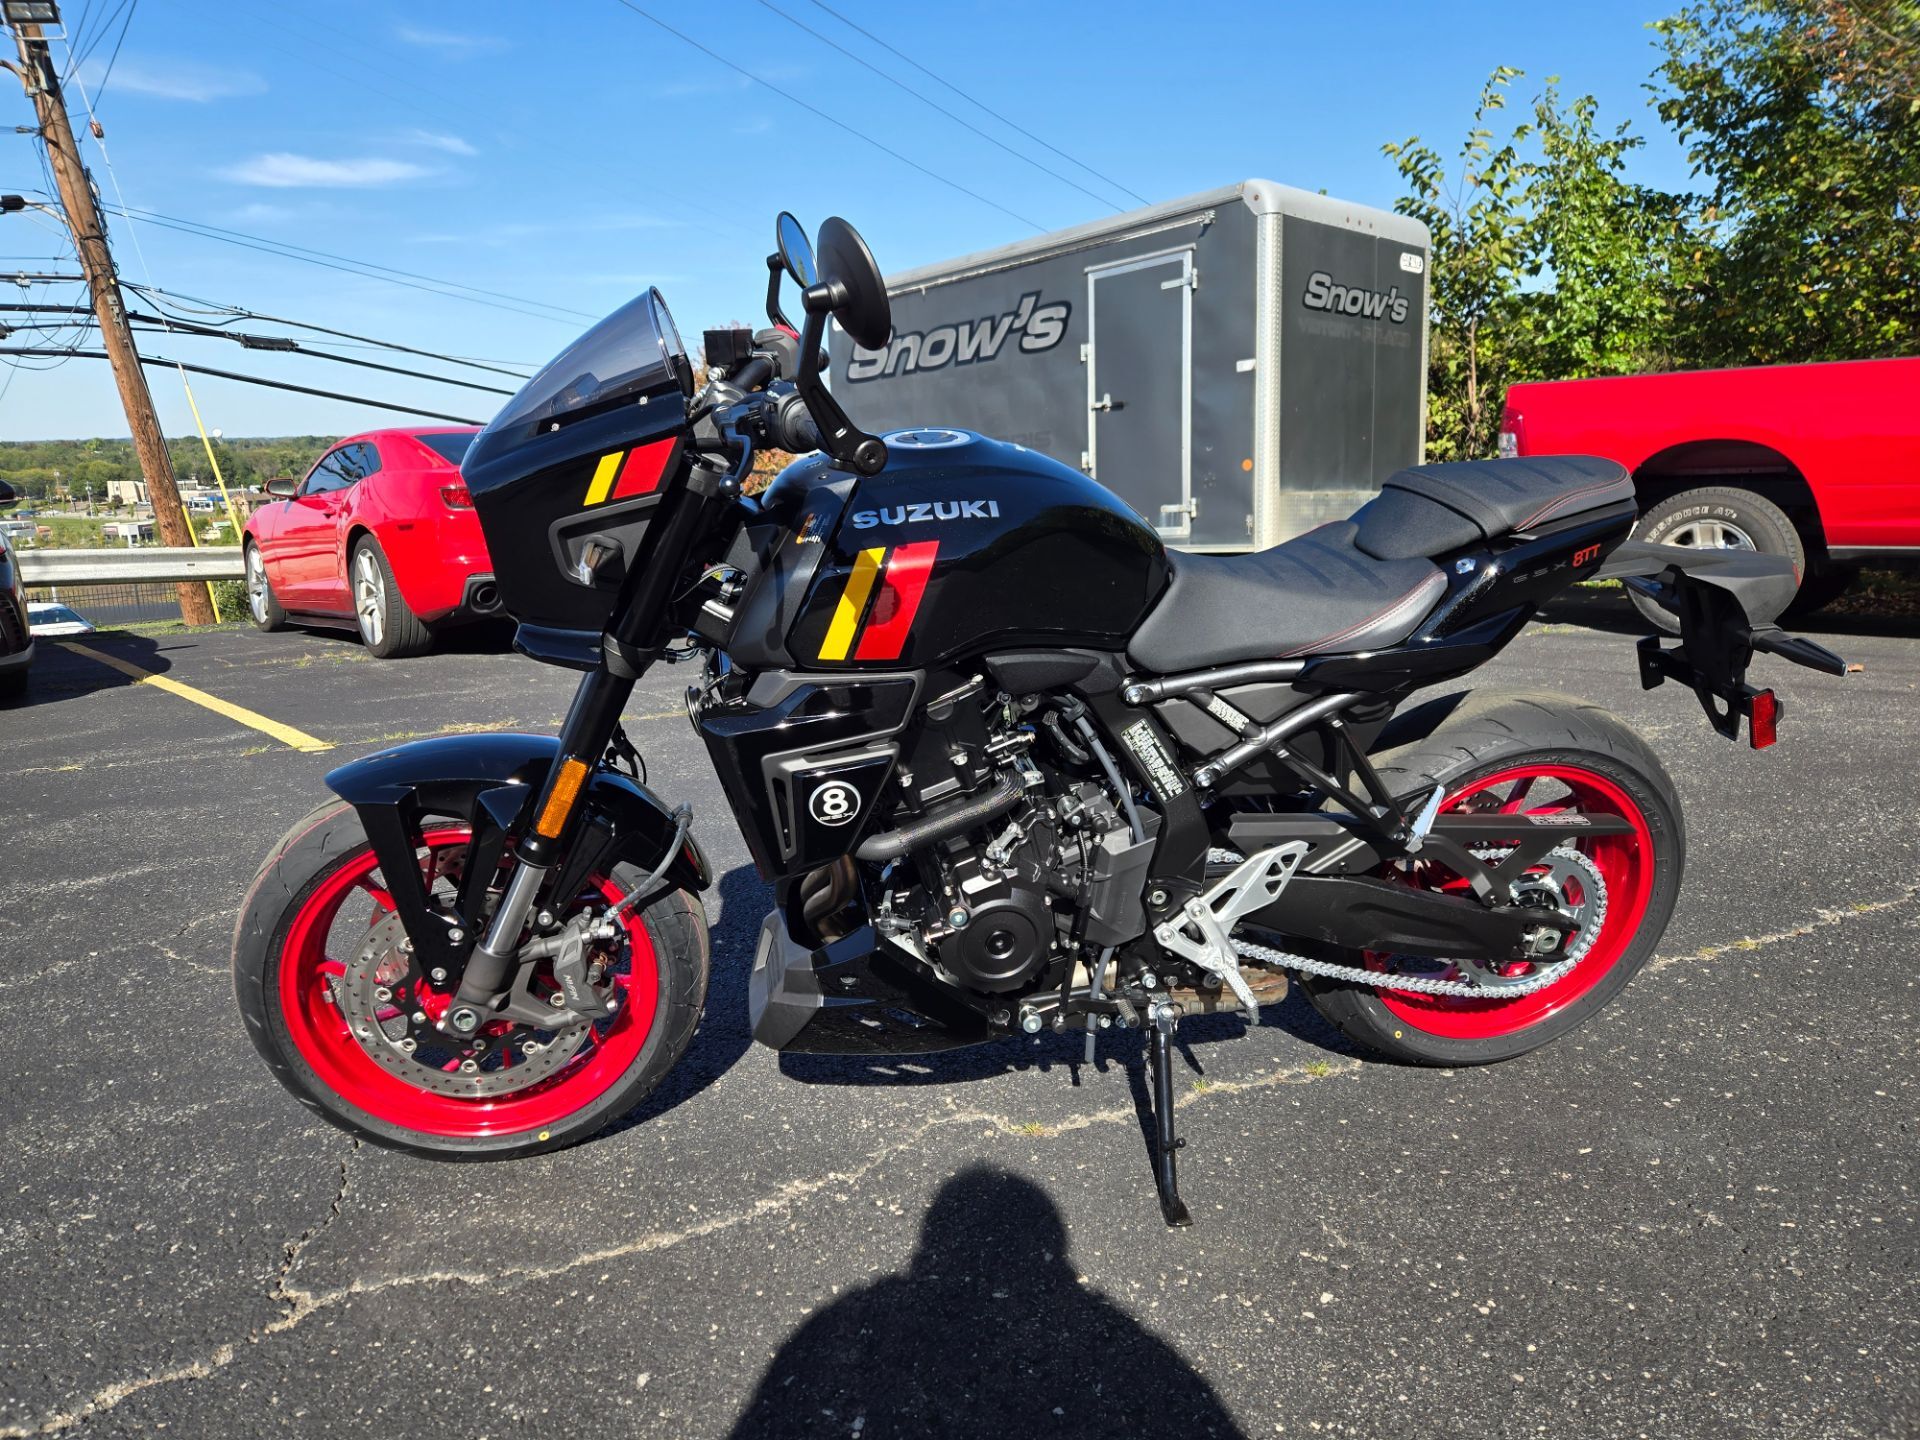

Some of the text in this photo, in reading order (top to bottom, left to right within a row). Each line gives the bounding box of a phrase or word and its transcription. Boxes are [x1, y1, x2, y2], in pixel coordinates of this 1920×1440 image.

[1303, 271, 1409, 324] Snow's
[847, 290, 1072, 383] Snow's
[851, 500, 1000, 530] SUZUKI
[1513, 543, 1601, 584] GSX 8TT
[819, 810, 854, 821] GSX
[822, 788, 849, 815] 8
